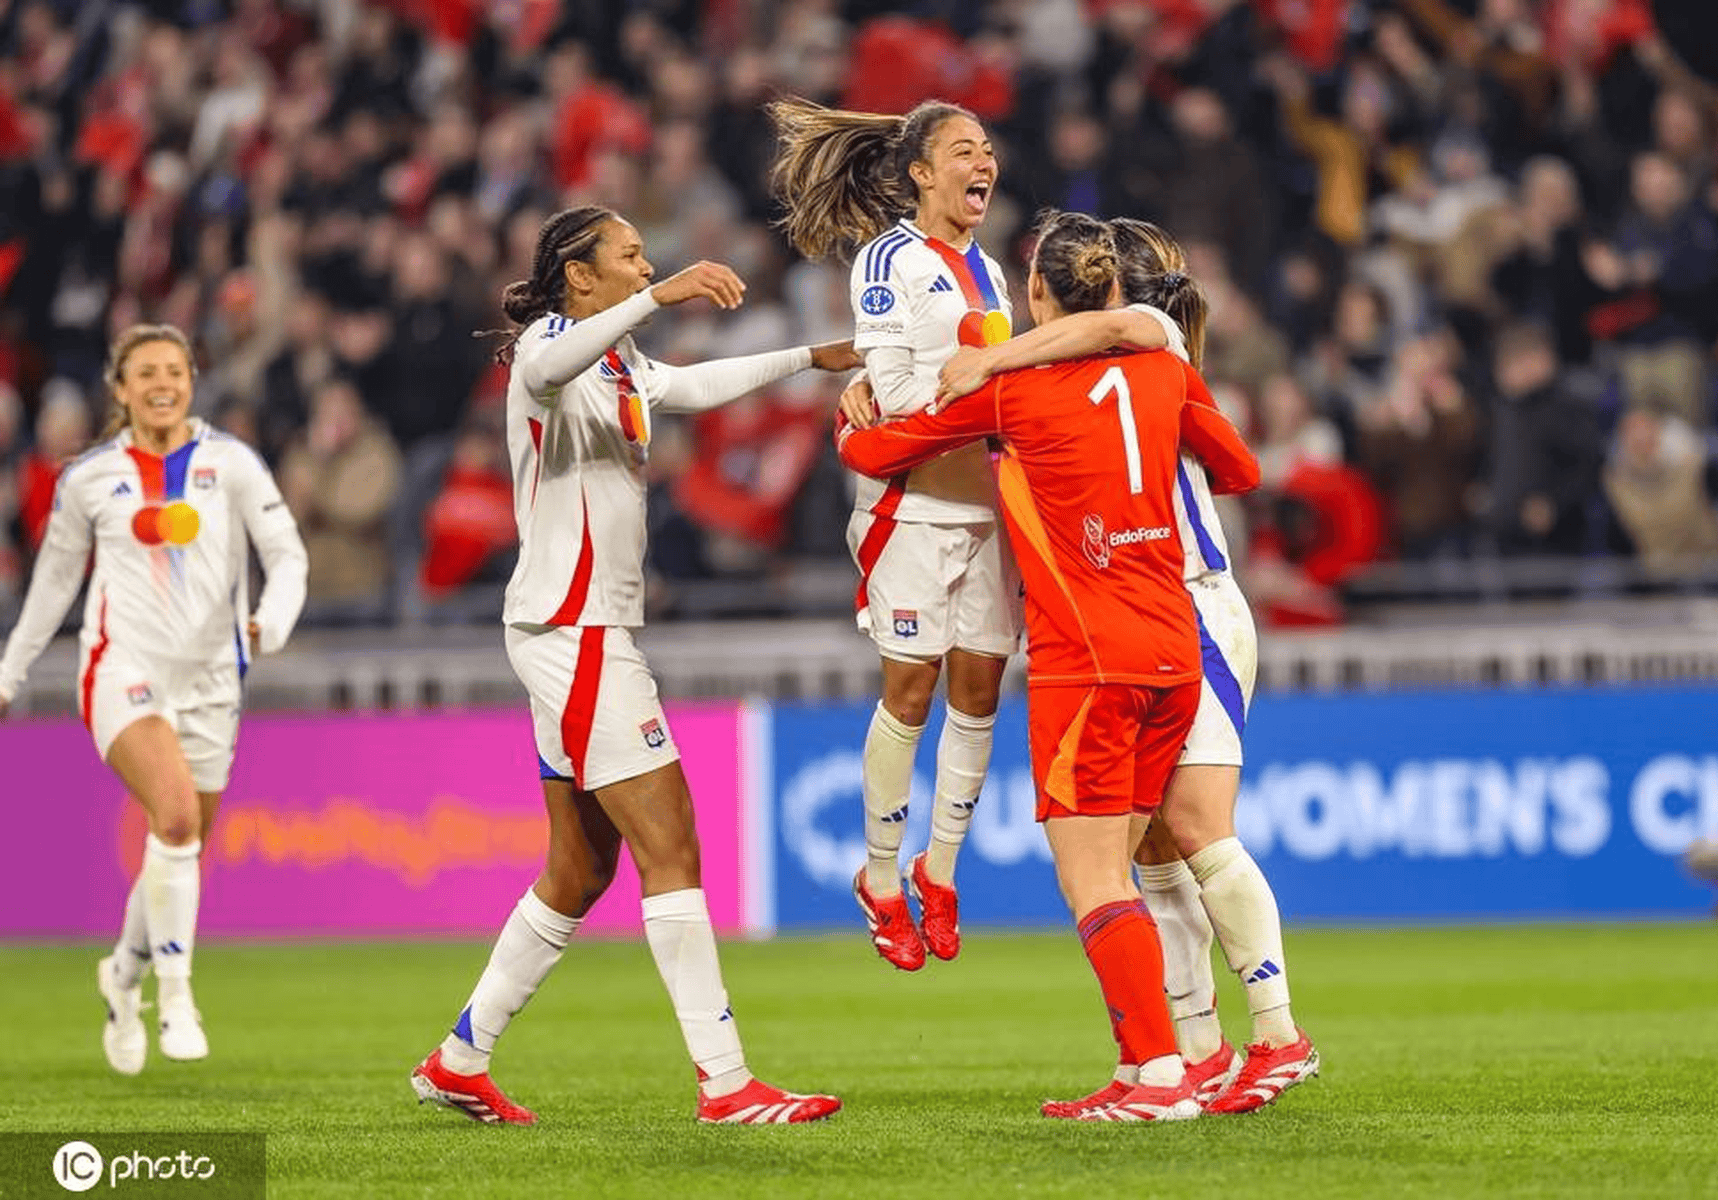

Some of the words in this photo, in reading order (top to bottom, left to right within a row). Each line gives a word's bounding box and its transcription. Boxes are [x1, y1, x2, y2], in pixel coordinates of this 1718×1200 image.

[1088, 366, 1144, 495] 1
[1109, 526, 1171, 547] EndoFrance
[896, 621, 917, 633] OL
